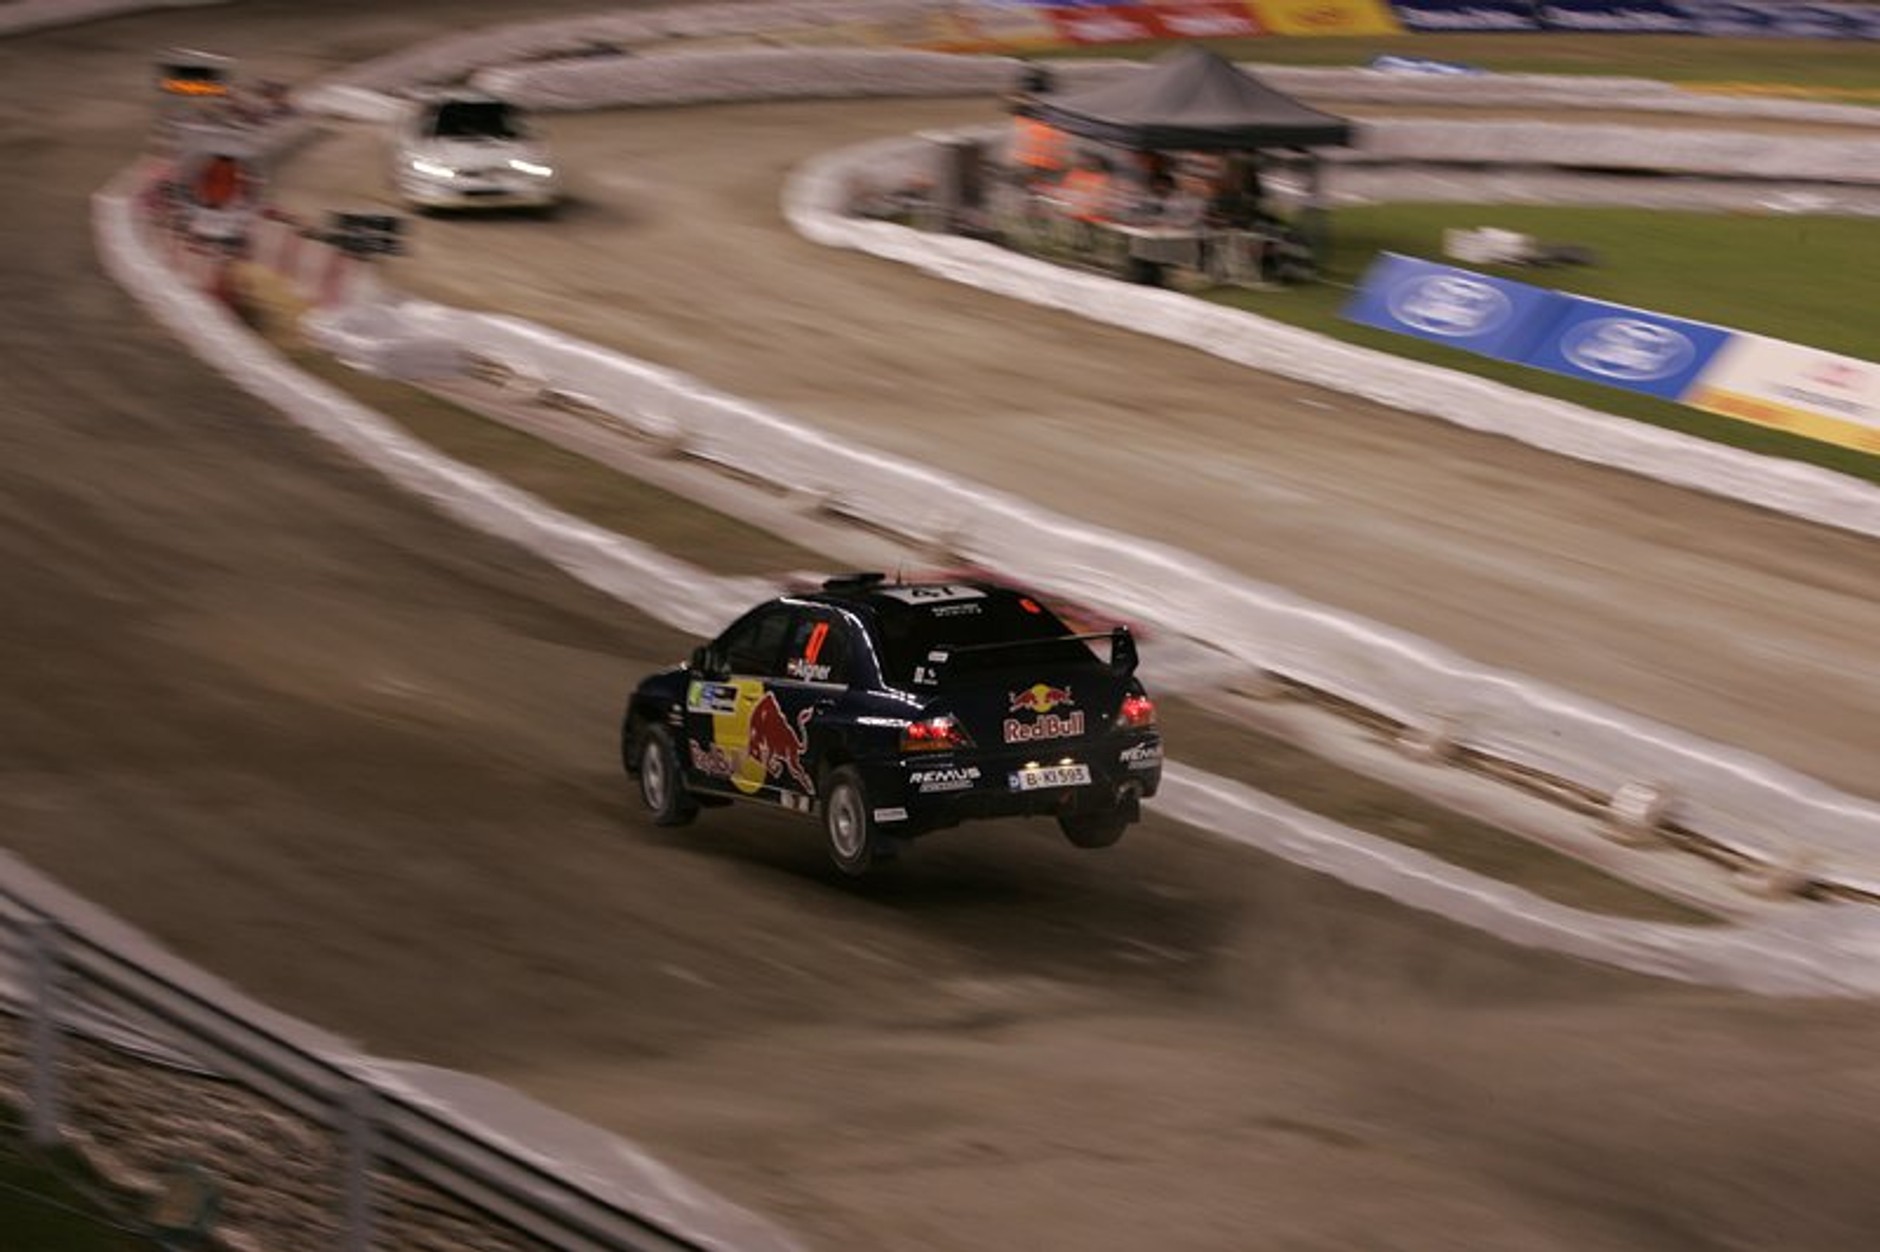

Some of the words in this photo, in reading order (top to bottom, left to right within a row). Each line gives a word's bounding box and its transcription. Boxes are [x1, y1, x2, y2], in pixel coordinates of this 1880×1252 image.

[795, 658, 831, 684] Aigner
[1003, 714, 1044, 743] Red
[1046, 710, 1085, 739] Bull
[909, 767, 981, 784] REMUS
